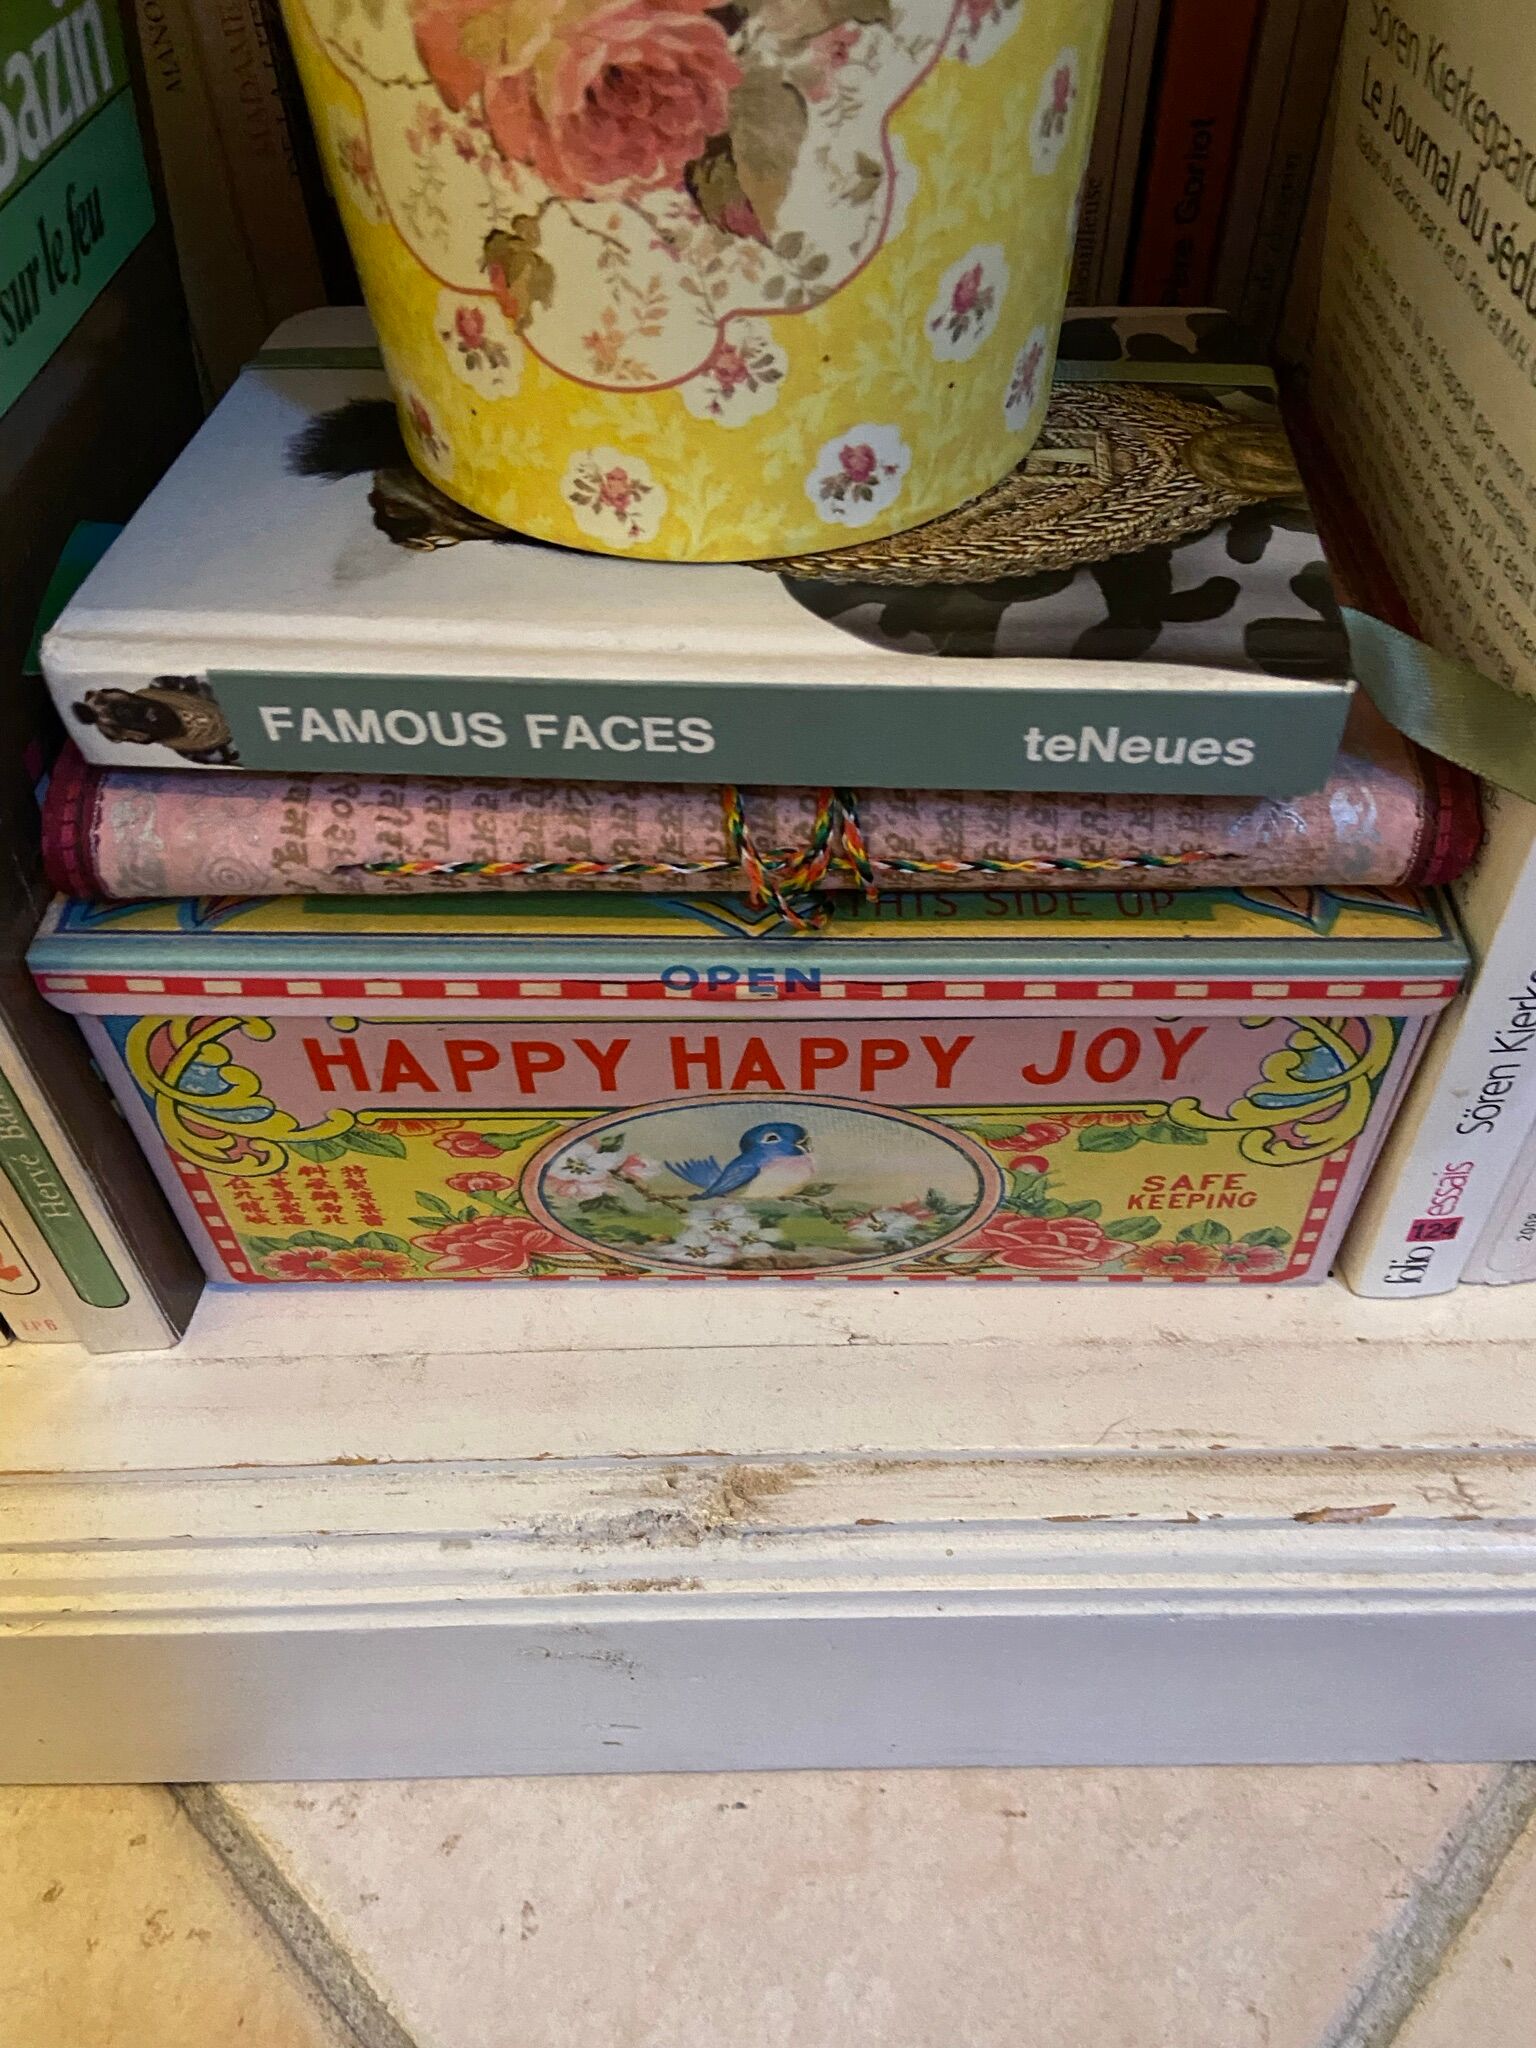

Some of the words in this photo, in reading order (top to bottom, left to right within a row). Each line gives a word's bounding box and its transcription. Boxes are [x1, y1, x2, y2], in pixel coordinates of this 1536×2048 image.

[1361, 56, 1382, 121] Le
[1383, 84, 1460, 206] Journal
[1458, 173, 1490, 246] du
[37, 214, 68, 297] le
[66, 183, 105, 286] feu
[259, 705, 508, 748] FAMOUS
[524, 714, 716, 754] FACES
[1024, 726, 1255, 766] teNeues
[984, 892, 1094, 917] SIDE
[660, 965, 821, 993] OPEN
[302, 1037, 631, 1094] HAPPY
[669, 1036, 975, 1092] HAPPY
[1021, 1026, 1209, 1086] JOY
[1456, 1064, 1521, 1135] Sören
[10, 1153, 73, 1219] Hervé
[1126, 1191, 1258, 1211] KEEPING
[1143, 1174, 1248, 1193] SAFE
[1427, 1161, 1475, 1217] essais
[1412, 1220, 1459, 1241] 124
[1384, 1245, 1435, 1284] folio
